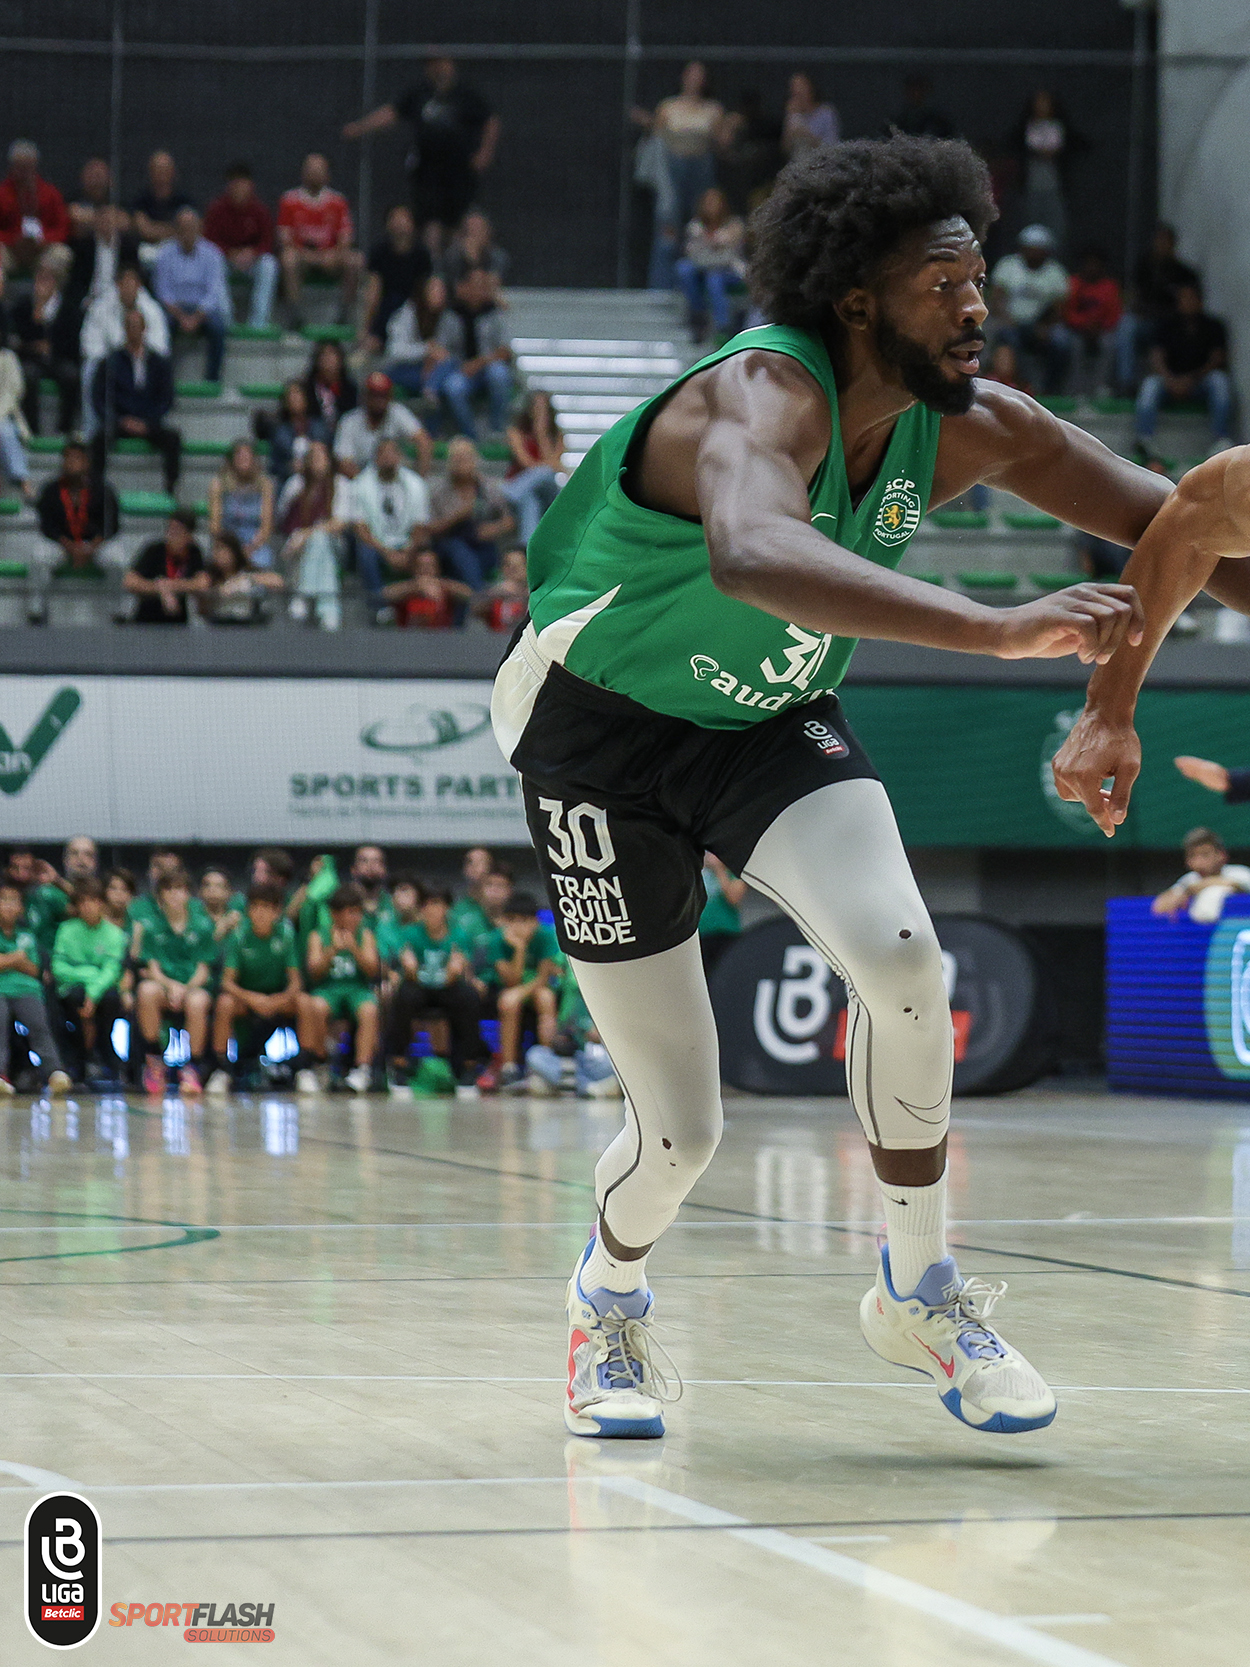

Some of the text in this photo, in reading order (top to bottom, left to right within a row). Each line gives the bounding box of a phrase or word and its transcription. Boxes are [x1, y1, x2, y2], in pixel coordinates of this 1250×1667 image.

[290, 772, 422, 798] SPORTS
[538, 796, 617, 874] 30
[551, 873, 623, 900] TRAN
[558, 896, 629, 923] QUILI
[563, 917, 637, 945] DADE
